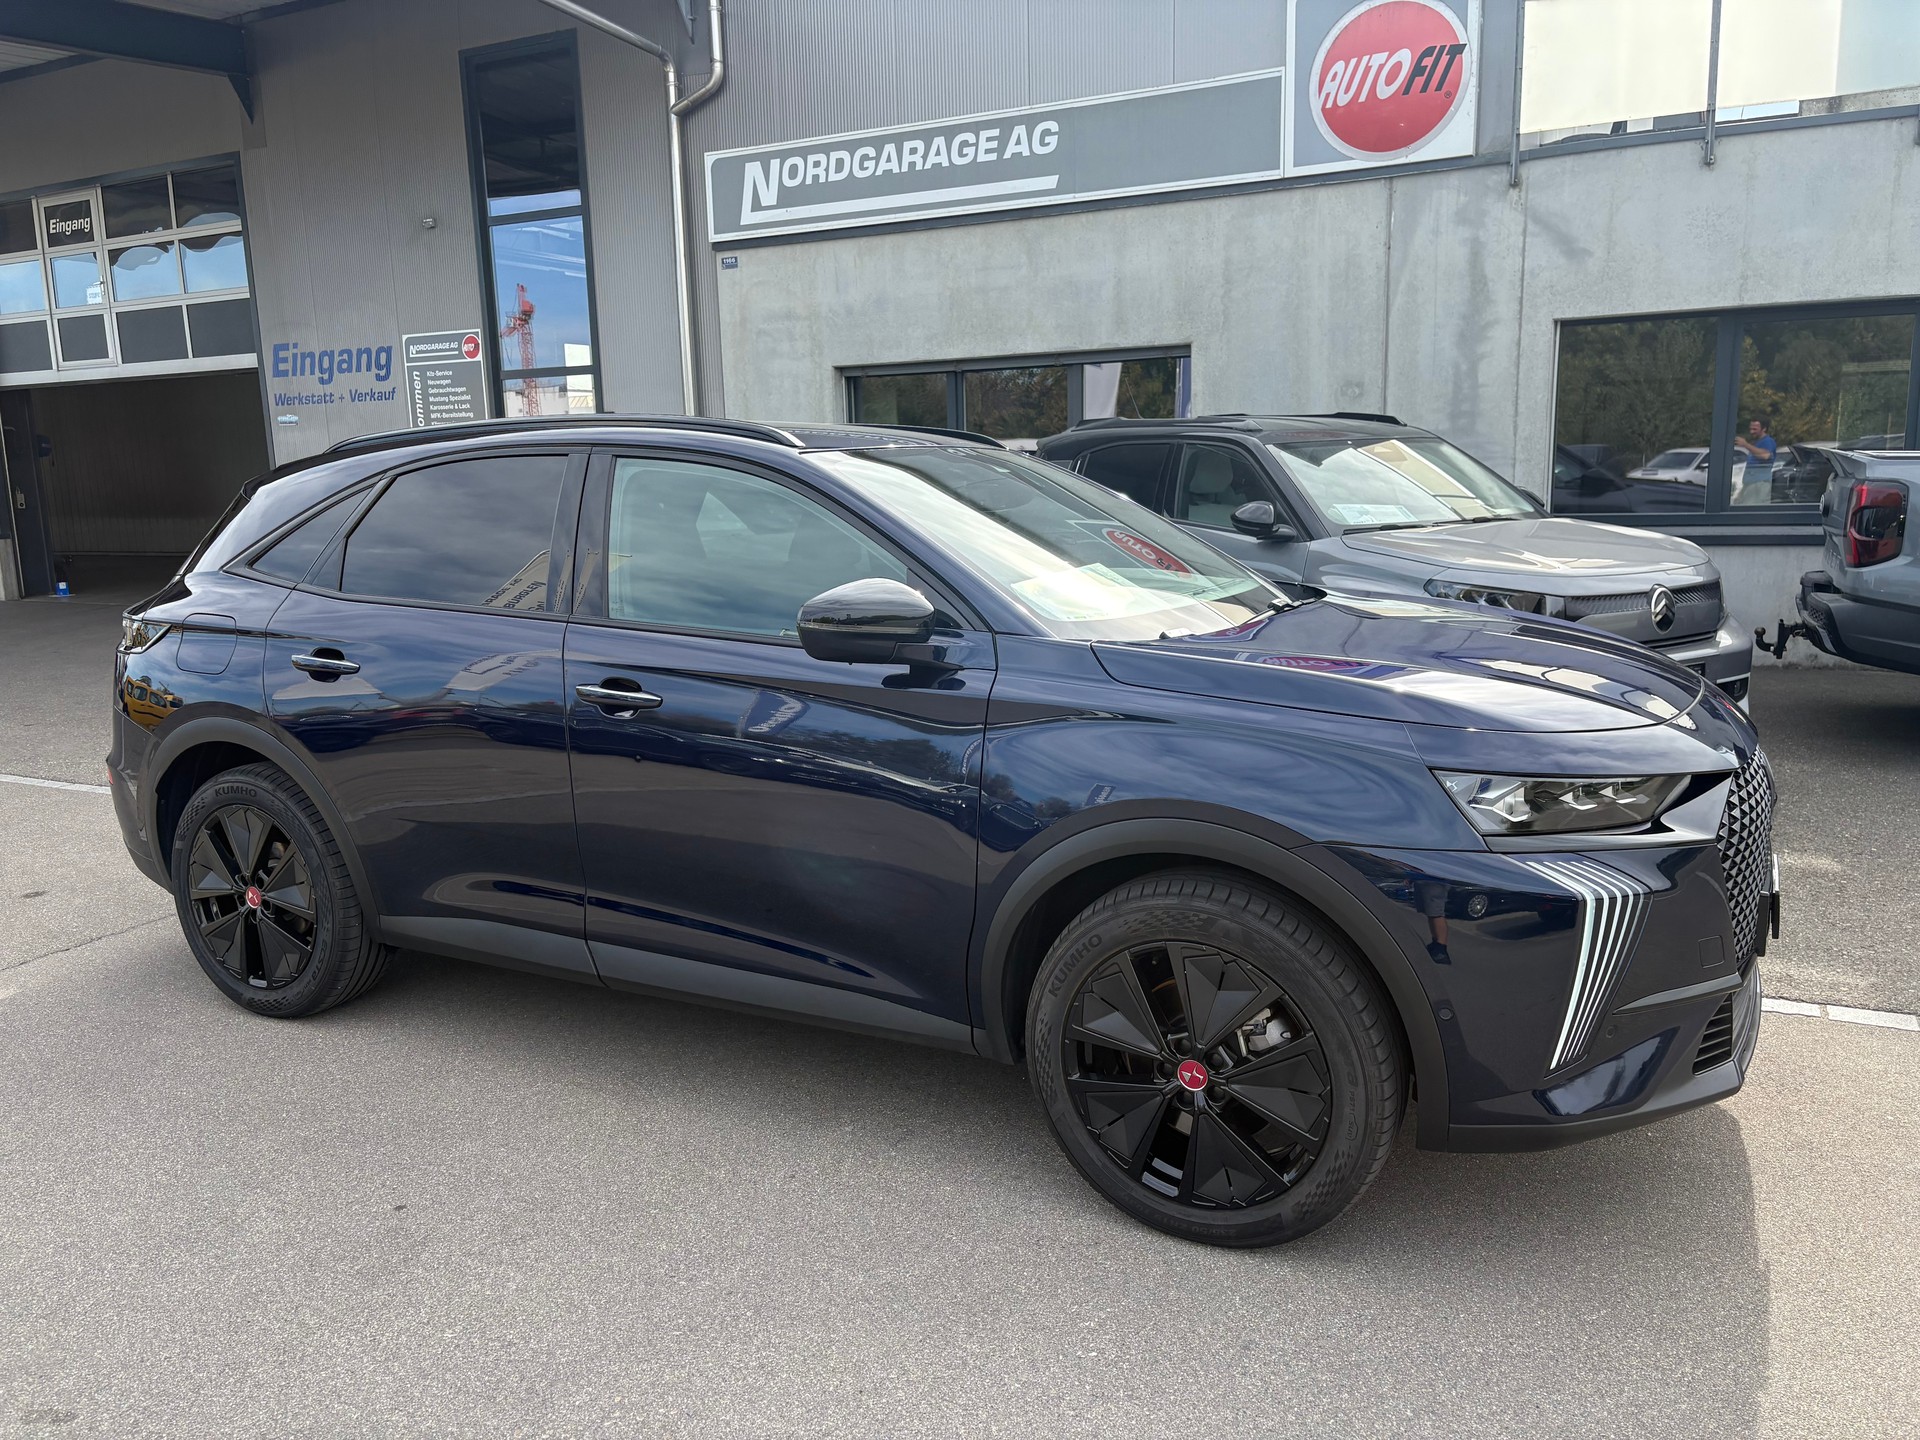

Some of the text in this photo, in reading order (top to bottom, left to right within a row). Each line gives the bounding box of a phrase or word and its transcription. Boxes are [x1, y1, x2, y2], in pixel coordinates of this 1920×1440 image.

[1319, 43, 1468, 109] AUTOFIT
[740, 120, 1060, 225] NORDGARAGE AG
[50, 217, 91, 235] Eingang
[409, 341, 459, 357] NORDGARAGE AG
[272, 342, 393, 385] Eingang
[274, 391, 334, 407] Werkstatt
[350, 386, 397, 403] Verkauf
[428, 386, 467, 394] Gebrauchtwagen
[214, 785, 258, 798] KUMHO
[1047, 934, 1103, 998] KUMHO
